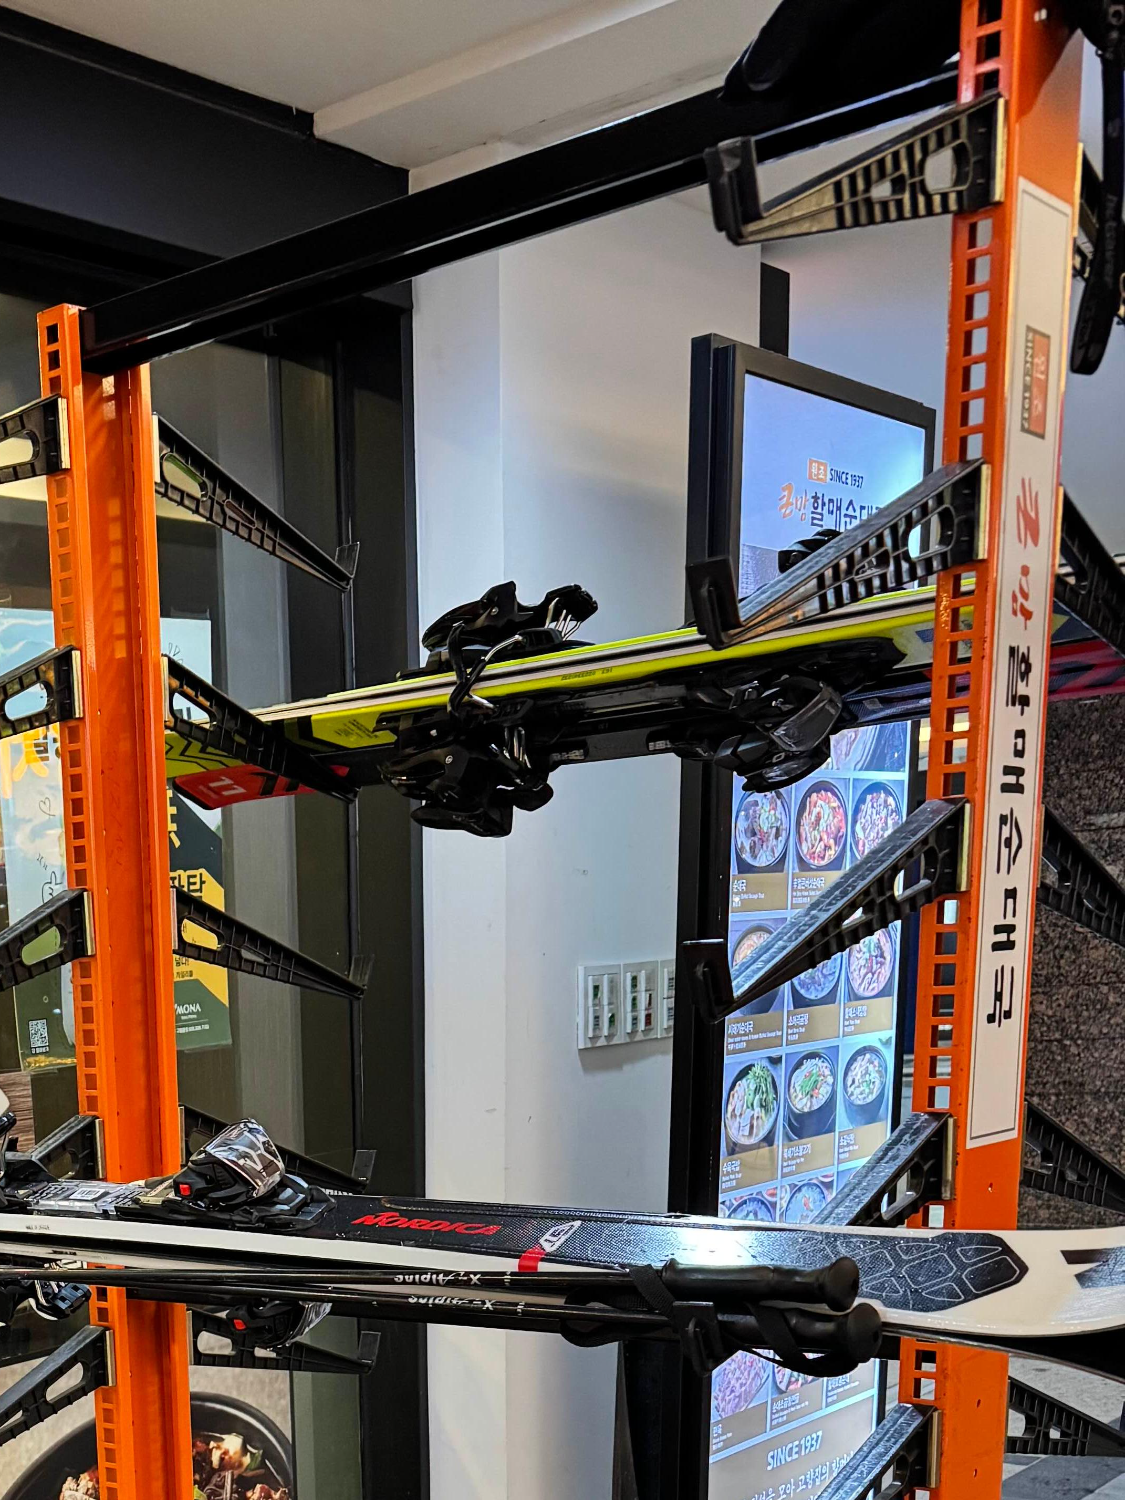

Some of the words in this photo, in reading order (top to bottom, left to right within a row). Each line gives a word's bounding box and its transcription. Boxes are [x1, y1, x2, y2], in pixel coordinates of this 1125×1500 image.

[829, 467, 849, 487] SINCE
[350, 1211, 502, 1236] NORDICA
[766, 1440, 800, 1471] SINCE
[800, 1431, 823, 1455] 1937
